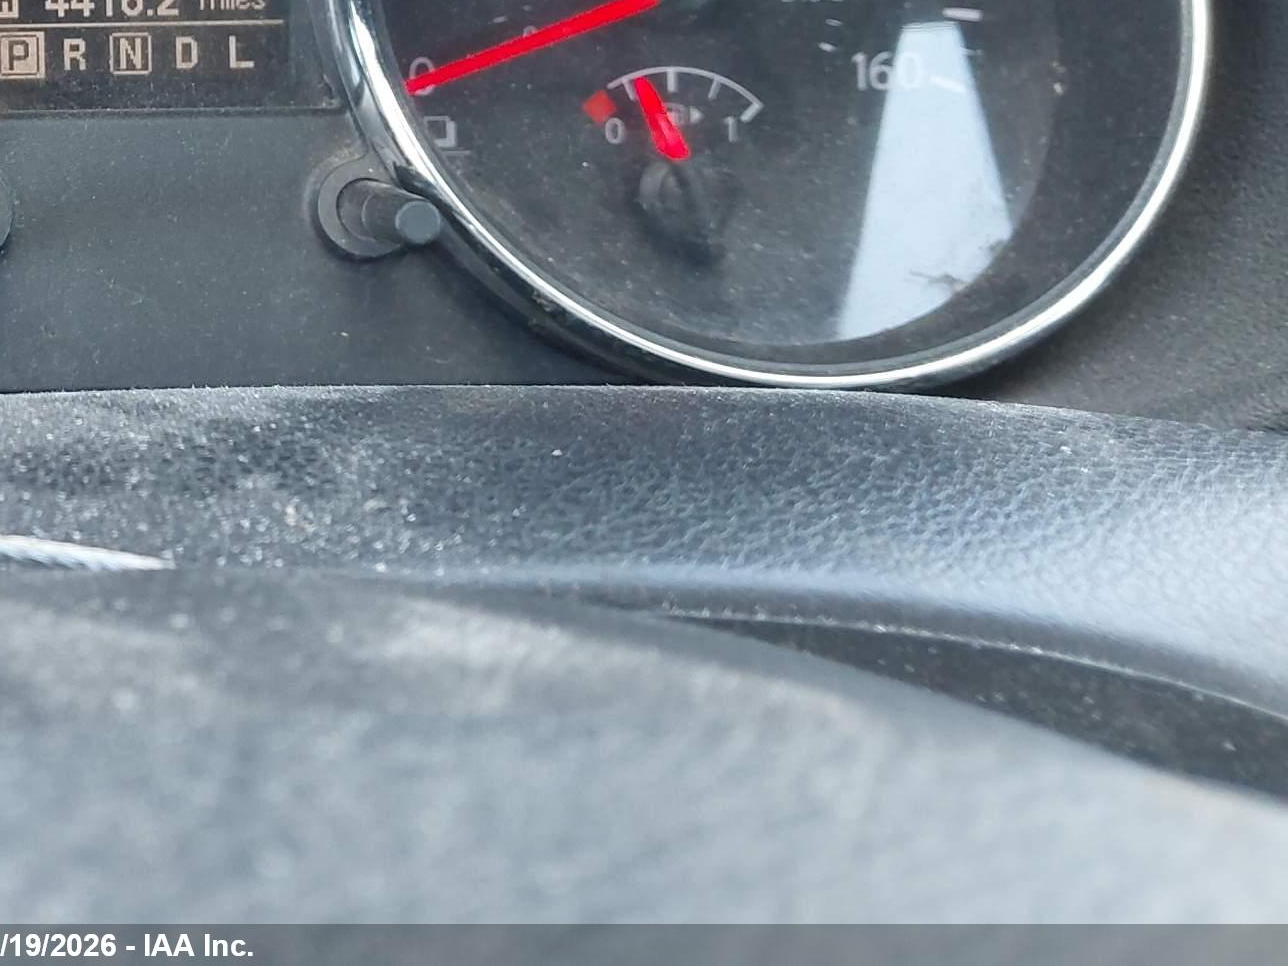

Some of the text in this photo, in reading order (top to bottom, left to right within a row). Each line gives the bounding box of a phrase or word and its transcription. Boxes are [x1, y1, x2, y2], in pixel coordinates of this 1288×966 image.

[64, 38, 86, 71] R
[119, 37, 142, 69] N
[176, 36, 198, 69] D
[229, 35, 255, 69] L
[851, 51, 923, 91] 160
[605, 117, 626, 144] 0
[723, 116, 739, 142] 1
